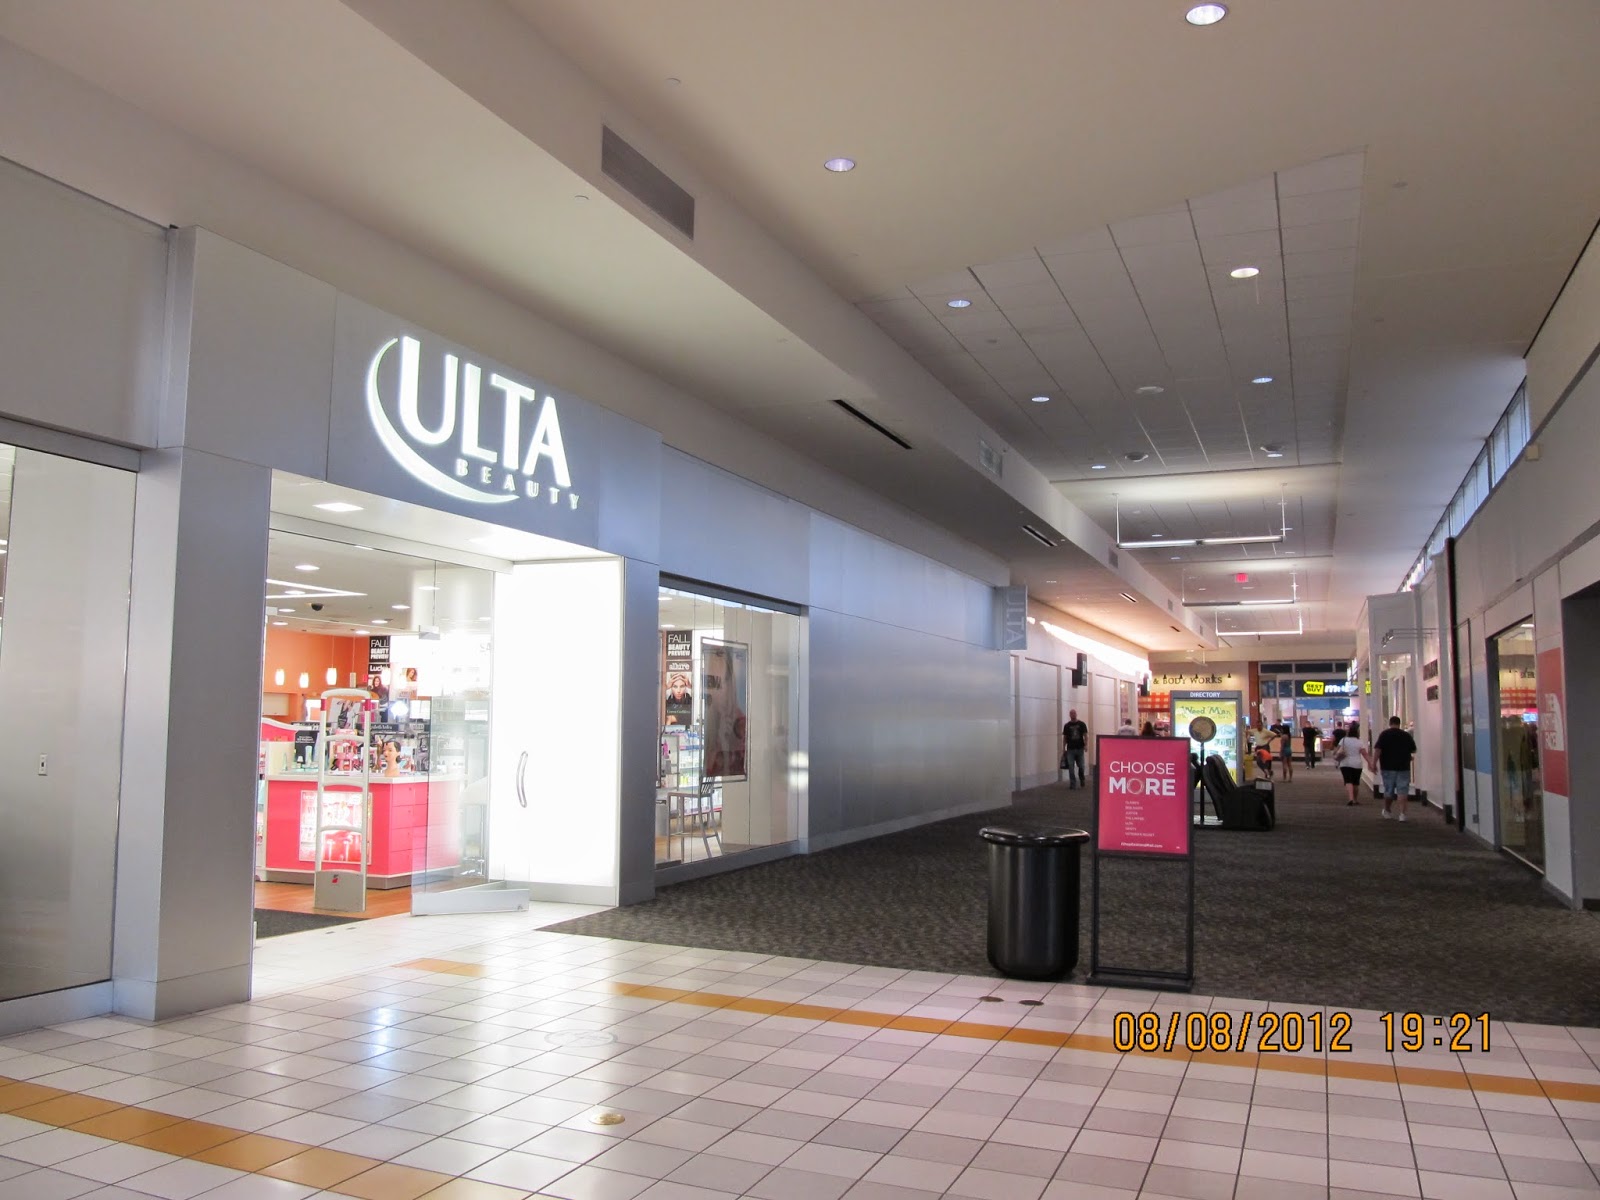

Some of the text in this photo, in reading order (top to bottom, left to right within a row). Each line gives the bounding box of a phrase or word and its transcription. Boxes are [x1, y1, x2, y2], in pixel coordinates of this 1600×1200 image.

[399, 335, 572, 488] ULTA
[455, 458, 580, 510] BEAUTY
[370, 639, 390, 648] FALL
[667, 633, 691, 644] FALL
[667, 643, 691, 651] BEAUTY
[1190, 676, 1223, 684] WORKS
[1109, 760, 1175, 775] CHOOSE
[1108, 776, 1176, 796] MORE
